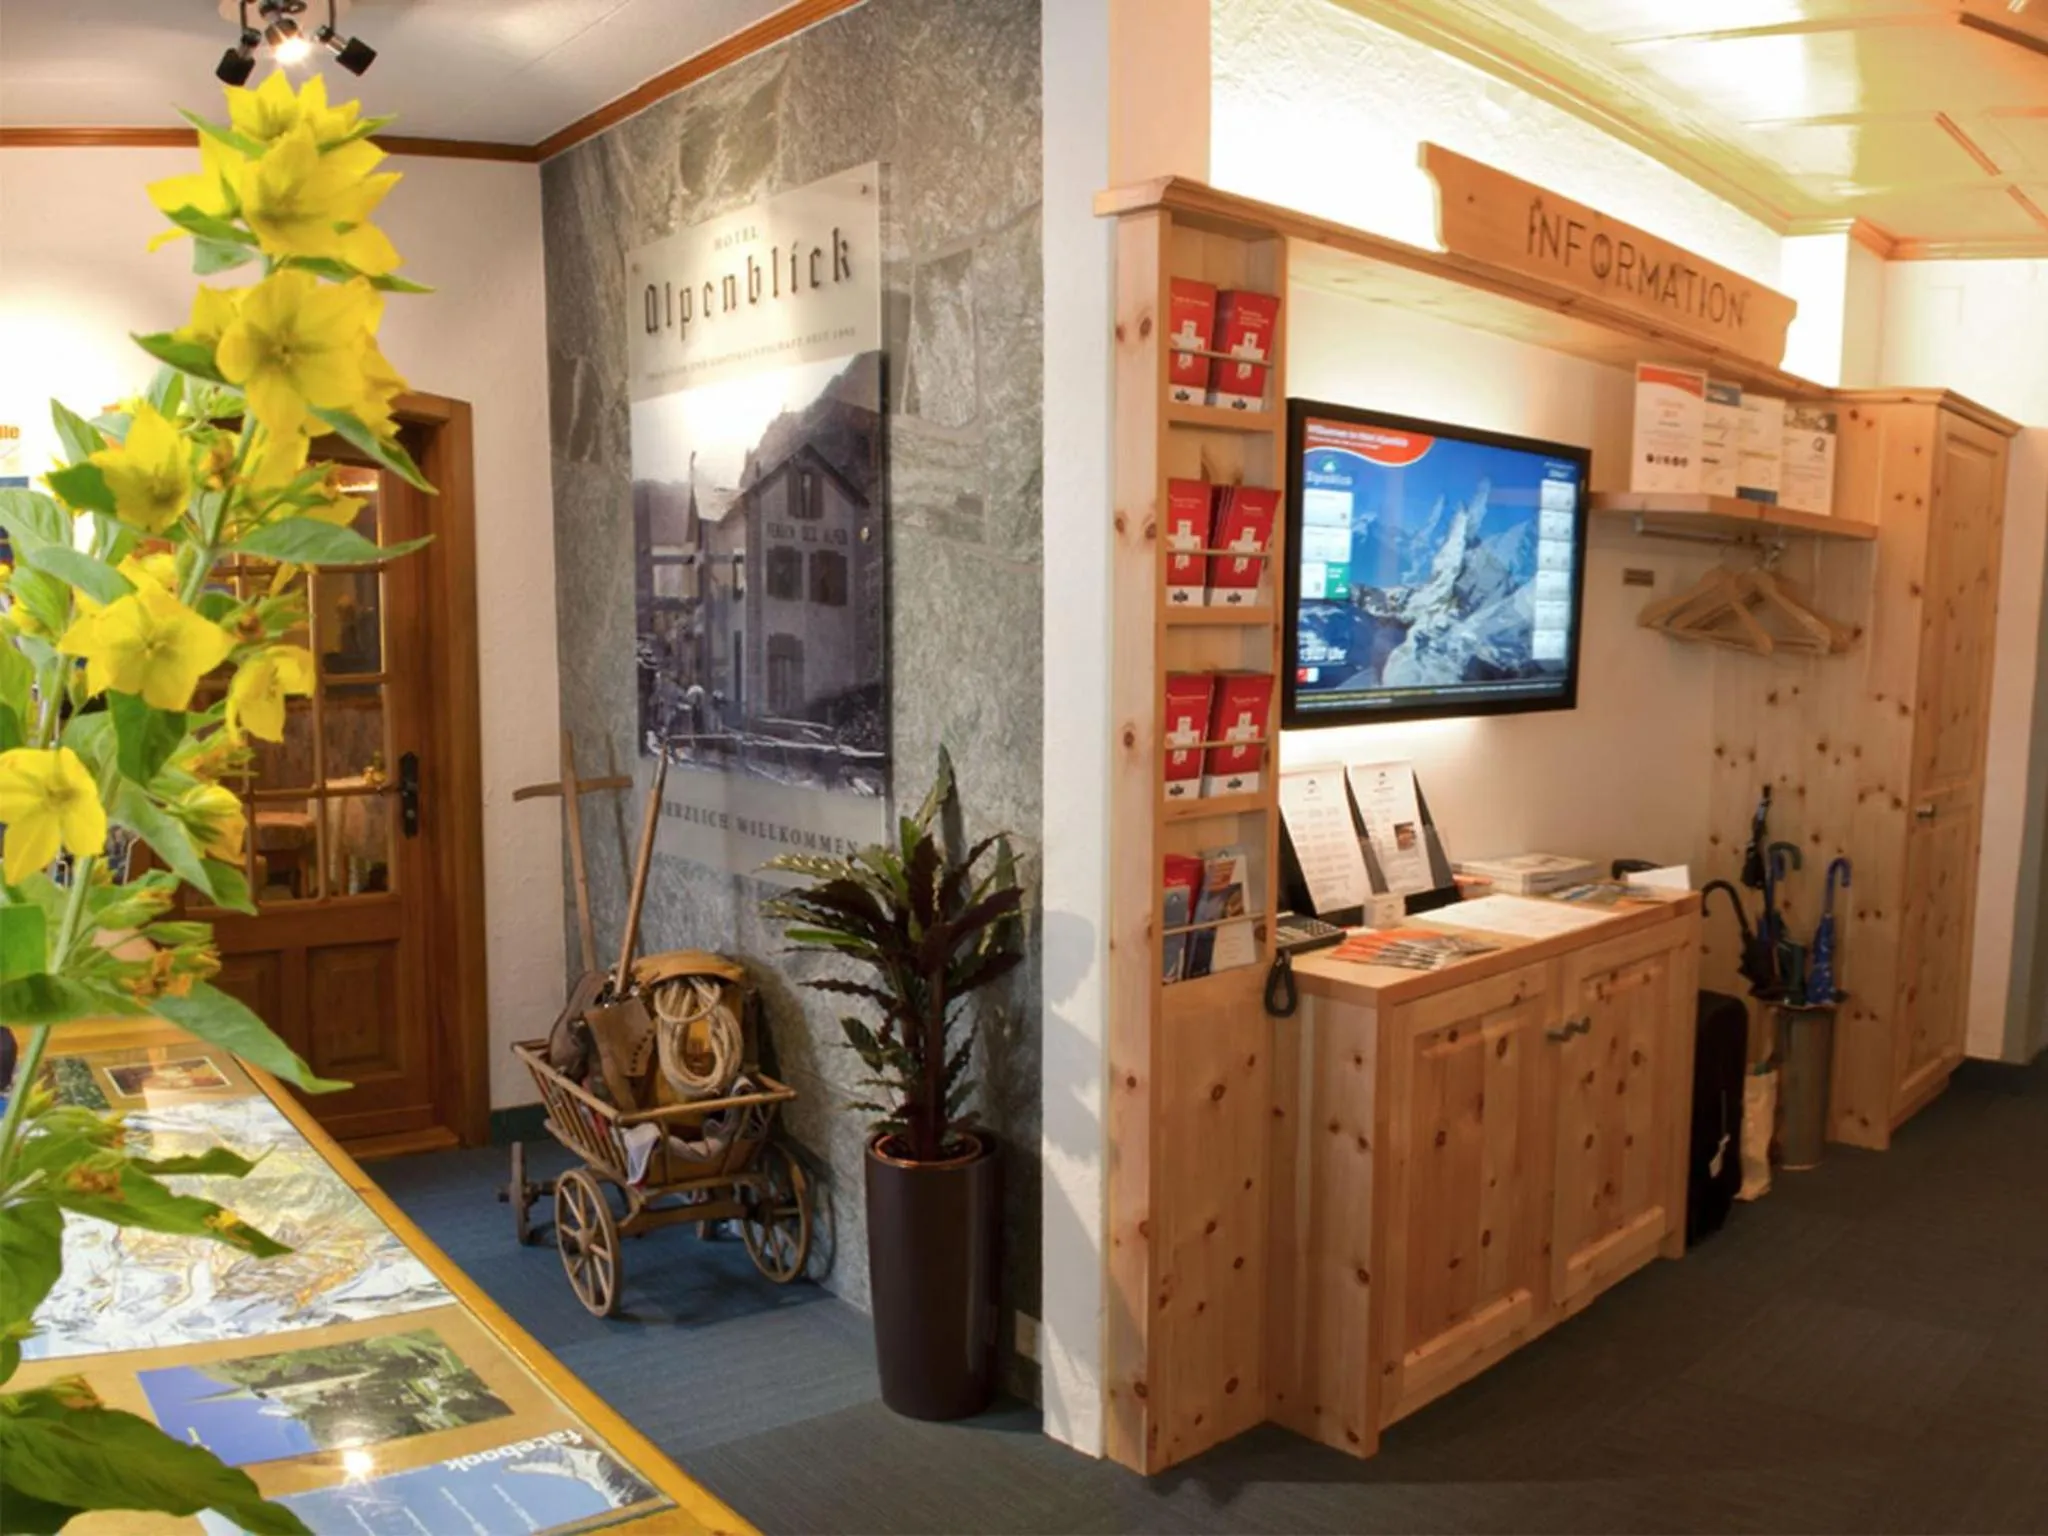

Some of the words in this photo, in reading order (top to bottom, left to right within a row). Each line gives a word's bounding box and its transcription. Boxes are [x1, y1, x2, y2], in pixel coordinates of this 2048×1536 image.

[714, 225, 760, 252] HOTEL
[1527, 196, 1749, 329] INFORMATION
[644, 226, 851, 341] Alpenblick
[662, 801, 729, 830] ERZLICH
[735, 816, 858, 857] WILLKOMMEN
[443, 1429, 583, 1472] facebook
